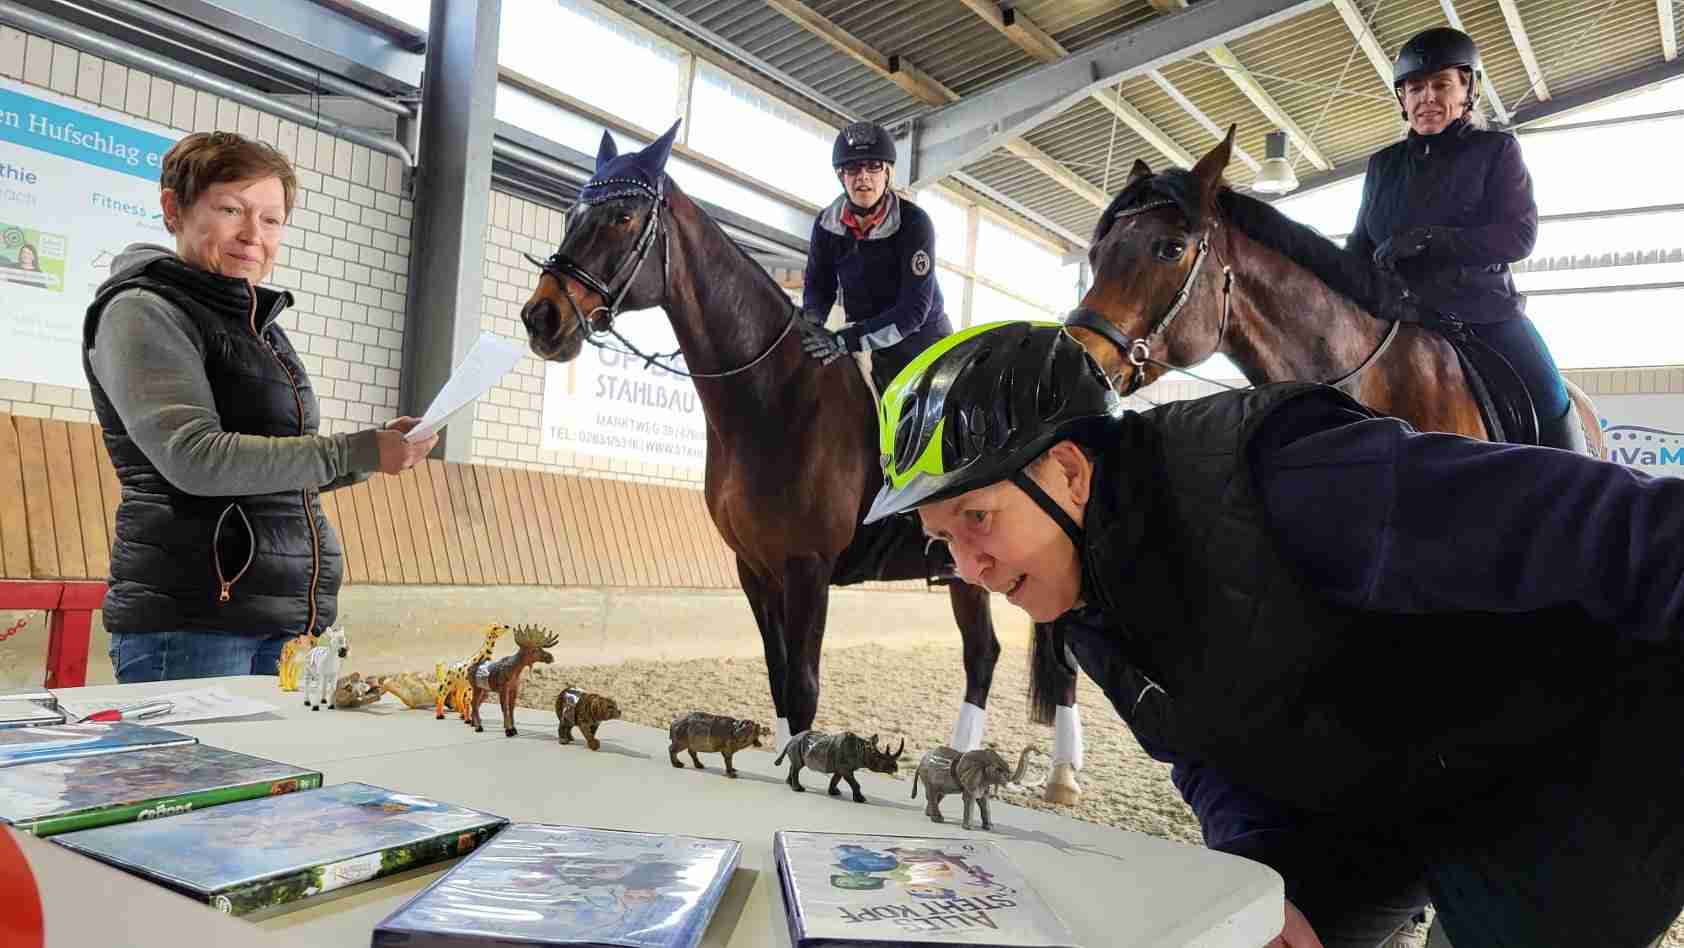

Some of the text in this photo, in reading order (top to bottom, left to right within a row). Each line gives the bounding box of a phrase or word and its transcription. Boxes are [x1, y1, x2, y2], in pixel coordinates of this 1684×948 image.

[27, 112, 140, 166] Hufschlag
[91, 192, 146, 217] Fitness
[595, 374, 696, 414] STAHLBAU
[837, 894, 1017, 924] STEHT KOPF
[893, 911, 999, 931] ALLES
